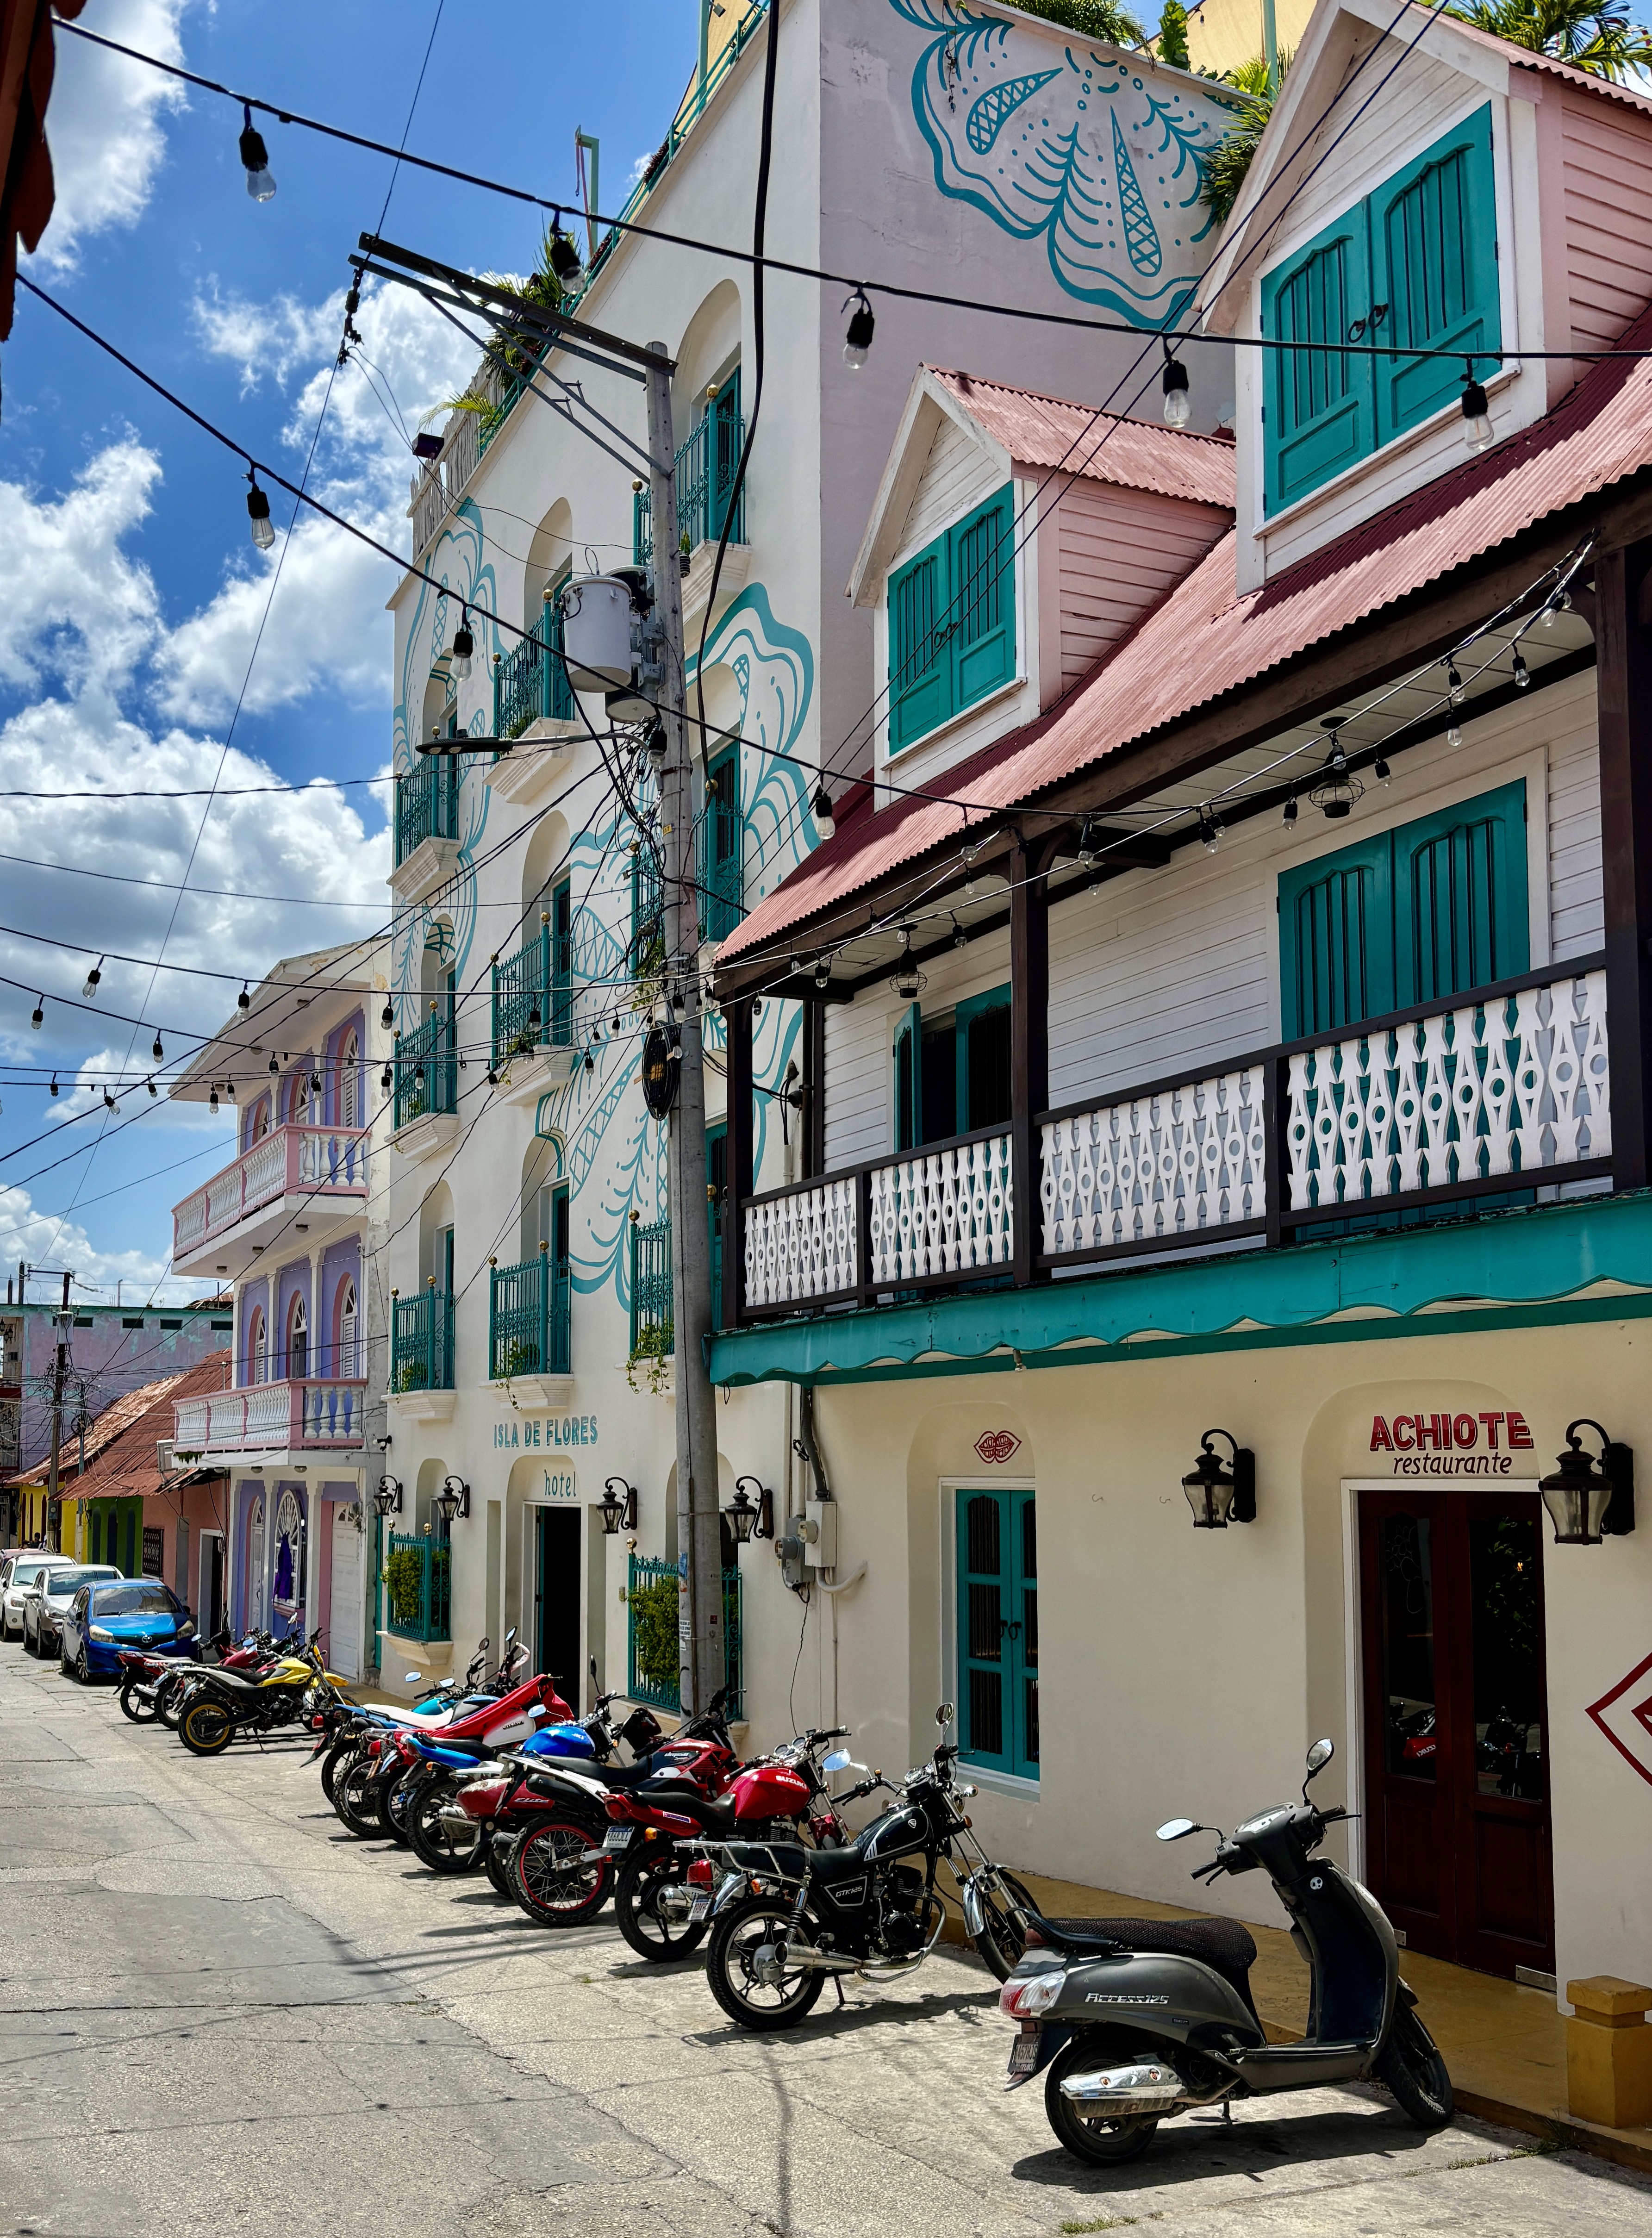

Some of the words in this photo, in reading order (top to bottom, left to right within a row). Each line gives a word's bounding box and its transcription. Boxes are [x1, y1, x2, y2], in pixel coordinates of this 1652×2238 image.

[494, 1423, 519, 1448] ISLA
[525, 1421, 540, 1446] DE
[546, 1415, 598, 1446] FLORES
[1369, 1412, 1534, 1452] ACHIOTE
[1393, 1452, 1512, 1475] restaurante
[544, 1469, 576, 1497] hotel
[775, 1775, 807, 1790] SUZUKI
[835, 1886, 863, 1897] GTK125
